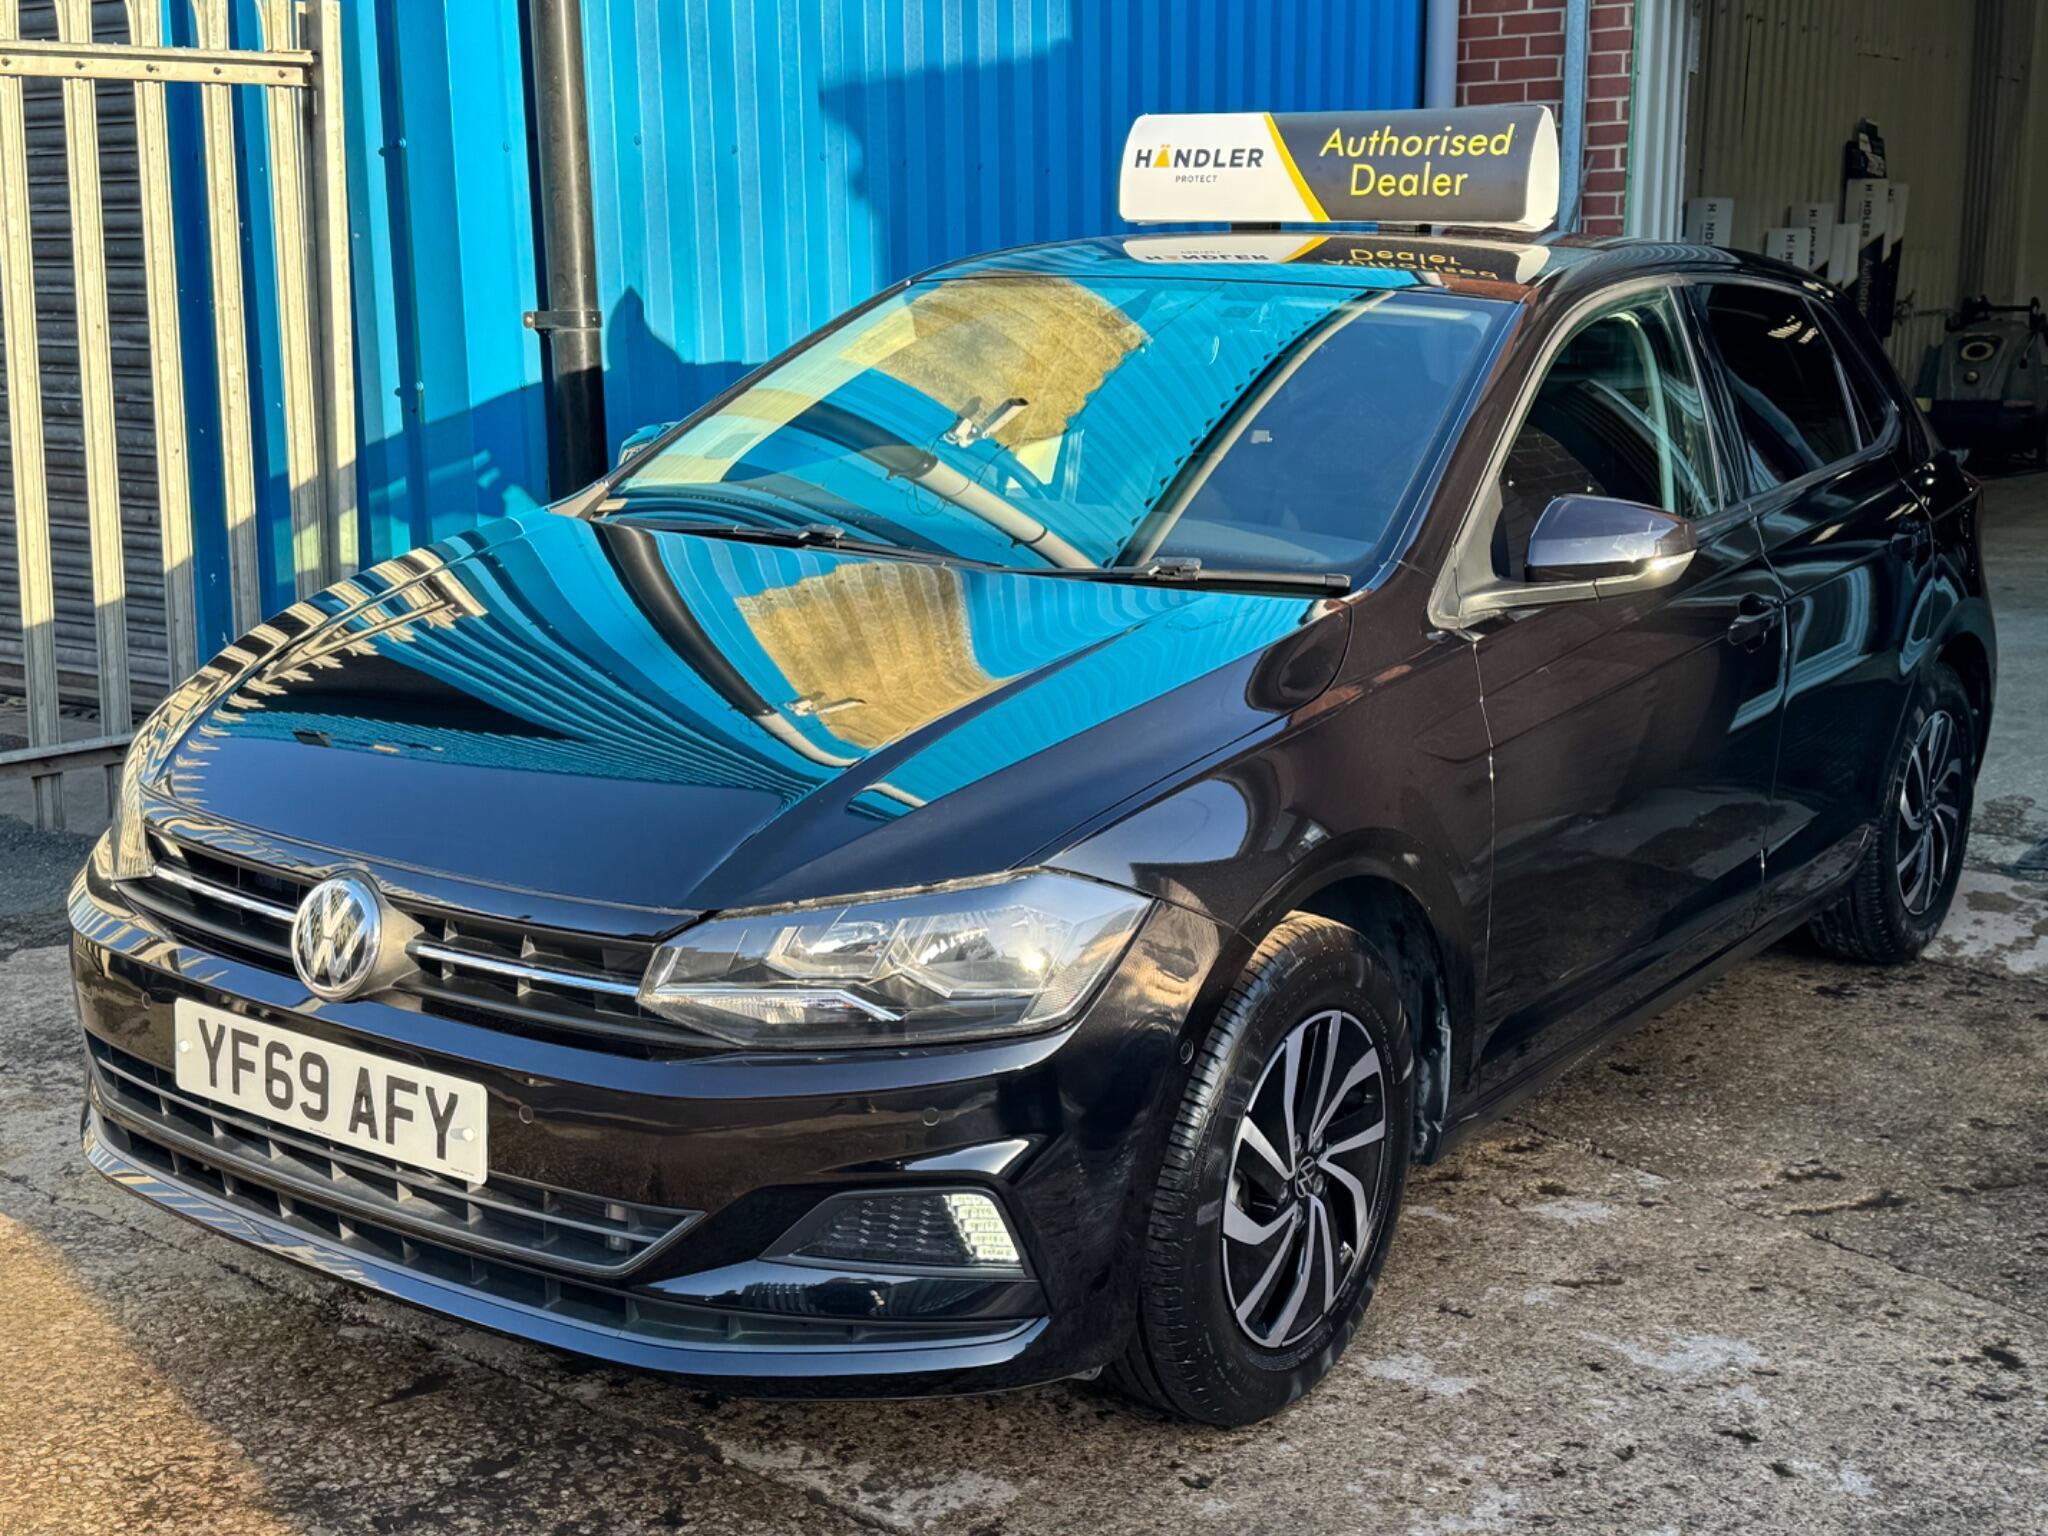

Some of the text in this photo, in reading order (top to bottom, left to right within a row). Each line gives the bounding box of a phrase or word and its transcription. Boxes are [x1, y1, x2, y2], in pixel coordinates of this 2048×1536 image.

[1135, 144, 1264, 168] HÄNDLER
[1319, 123, 1515, 157] Authorised
[1175, 175, 1217, 183] PROTECT
[1350, 161, 1468, 196] Dealer
[198, 1017, 459, 1161] YF69 AFY
